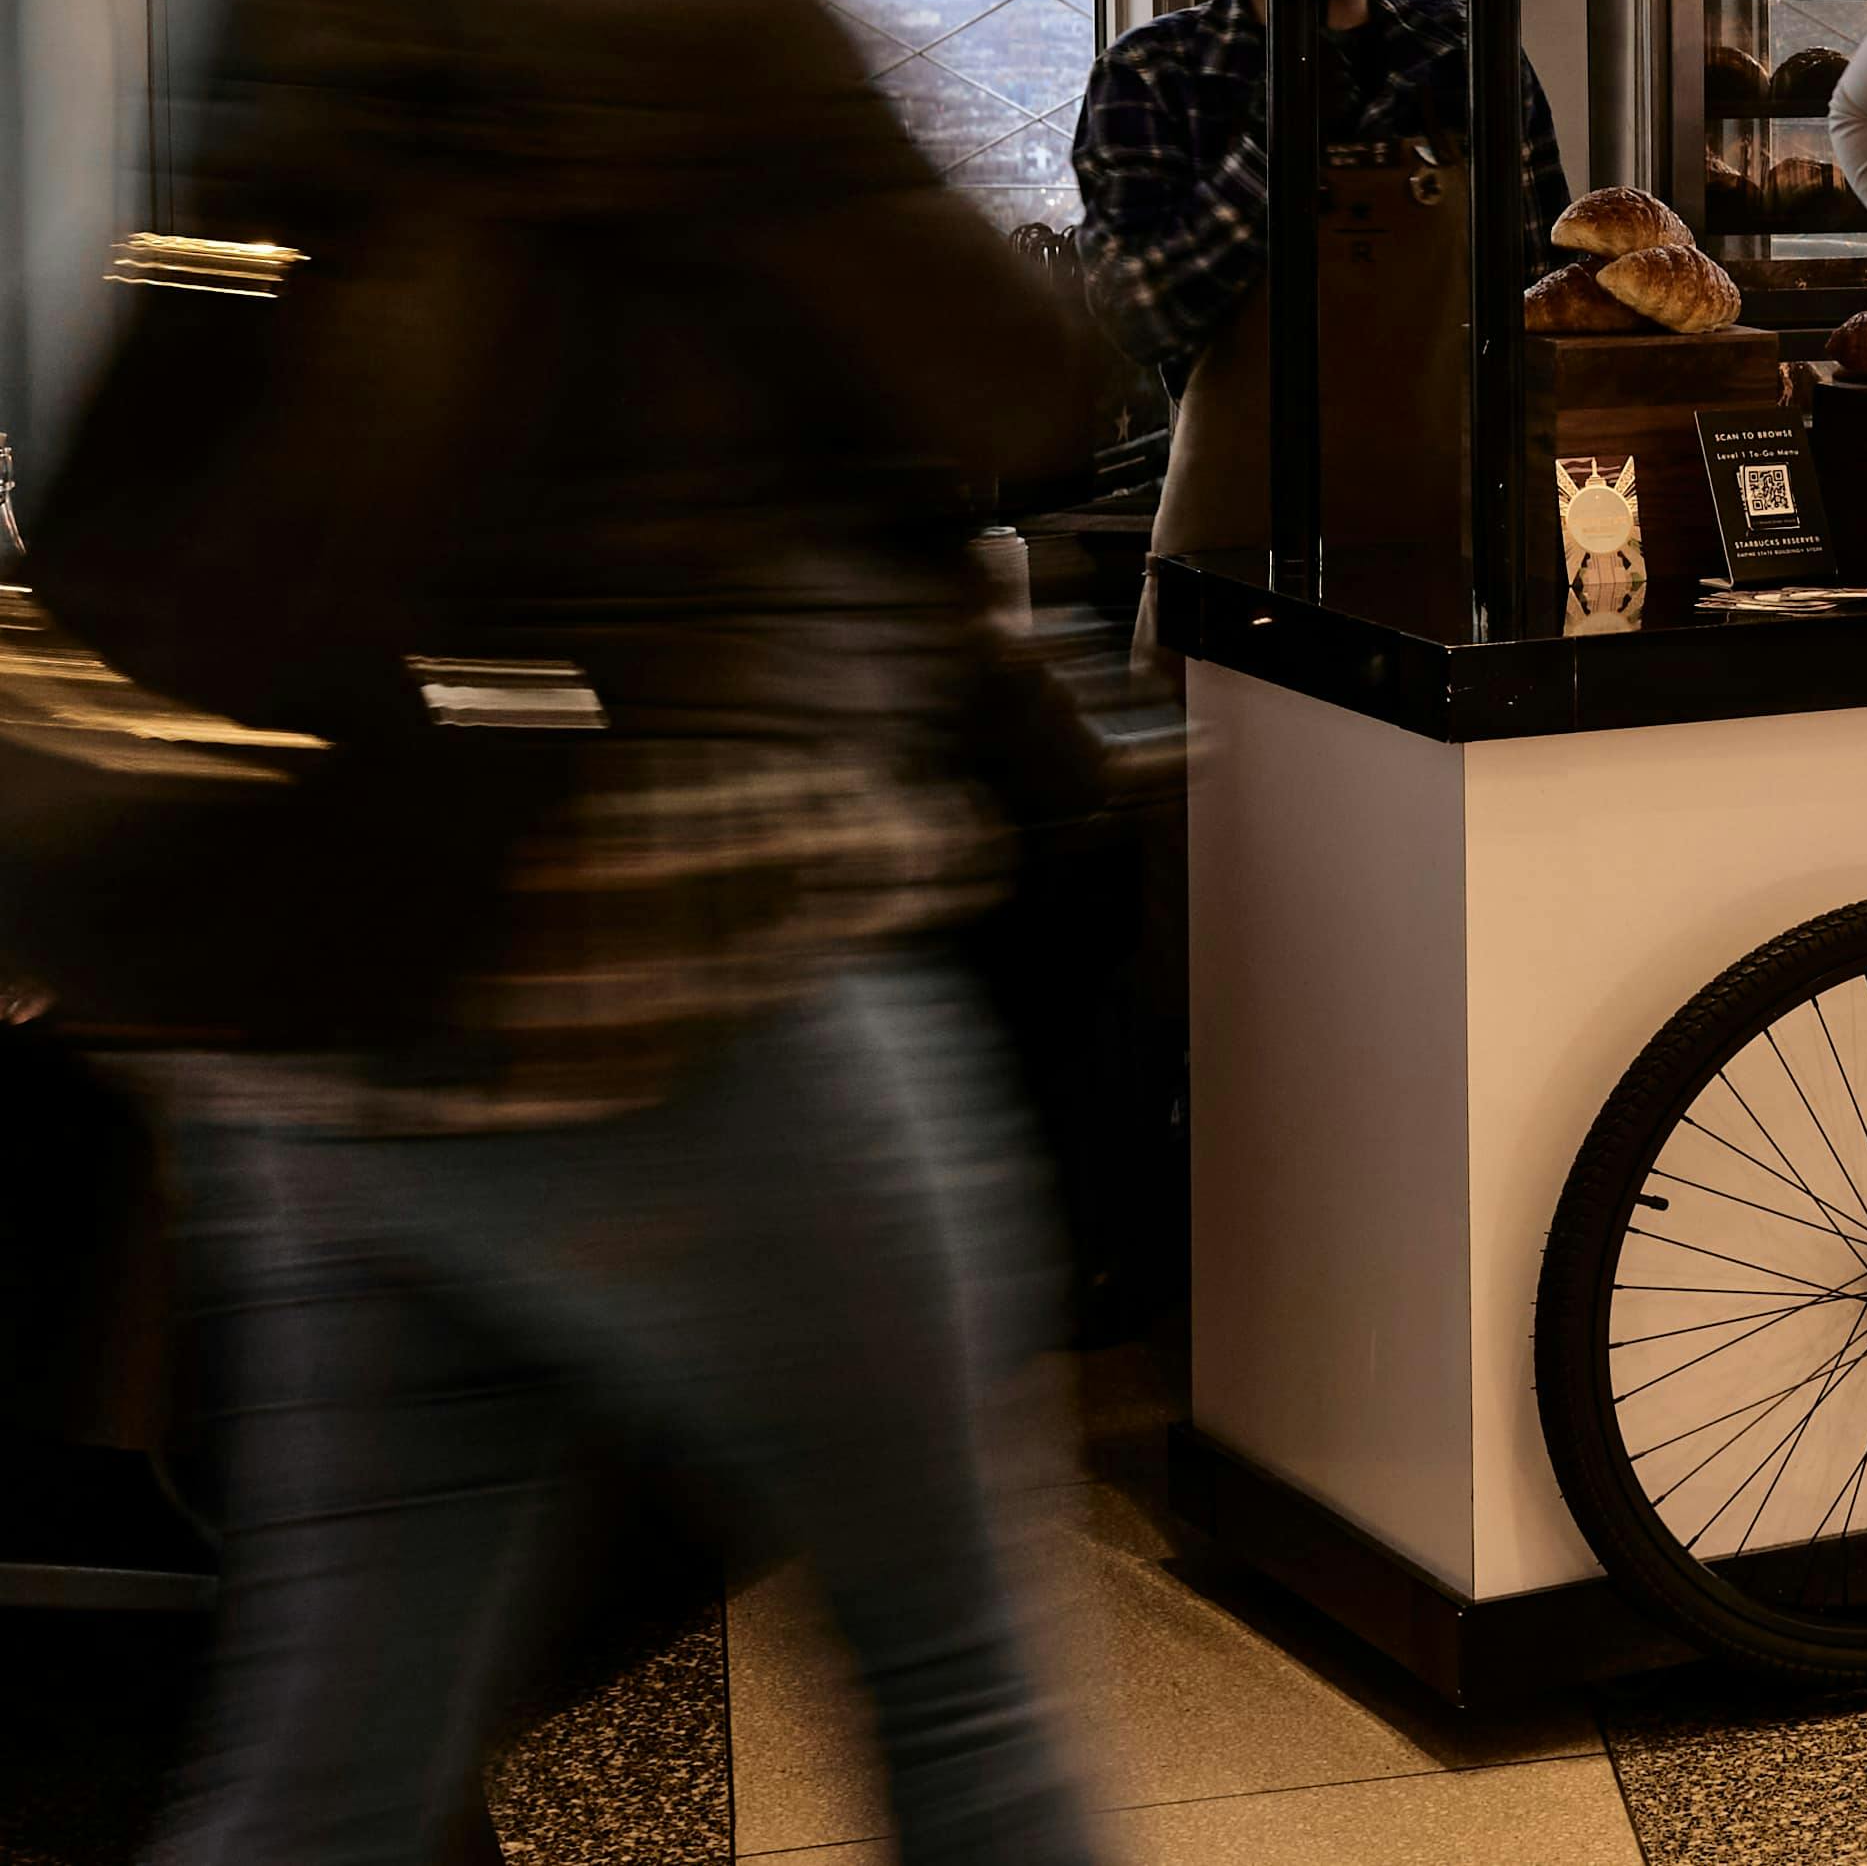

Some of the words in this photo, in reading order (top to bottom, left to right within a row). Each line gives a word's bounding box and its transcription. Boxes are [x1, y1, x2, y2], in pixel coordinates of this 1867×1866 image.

[1714, 433, 1739, 442] SCAN
[1742, 431, 1754, 439] TO
[1757, 429, 1792, 439] BROWSE
[1717, 451, 1738, 460] Level
[1735, 538, 1780, 549] STARBUCKS
